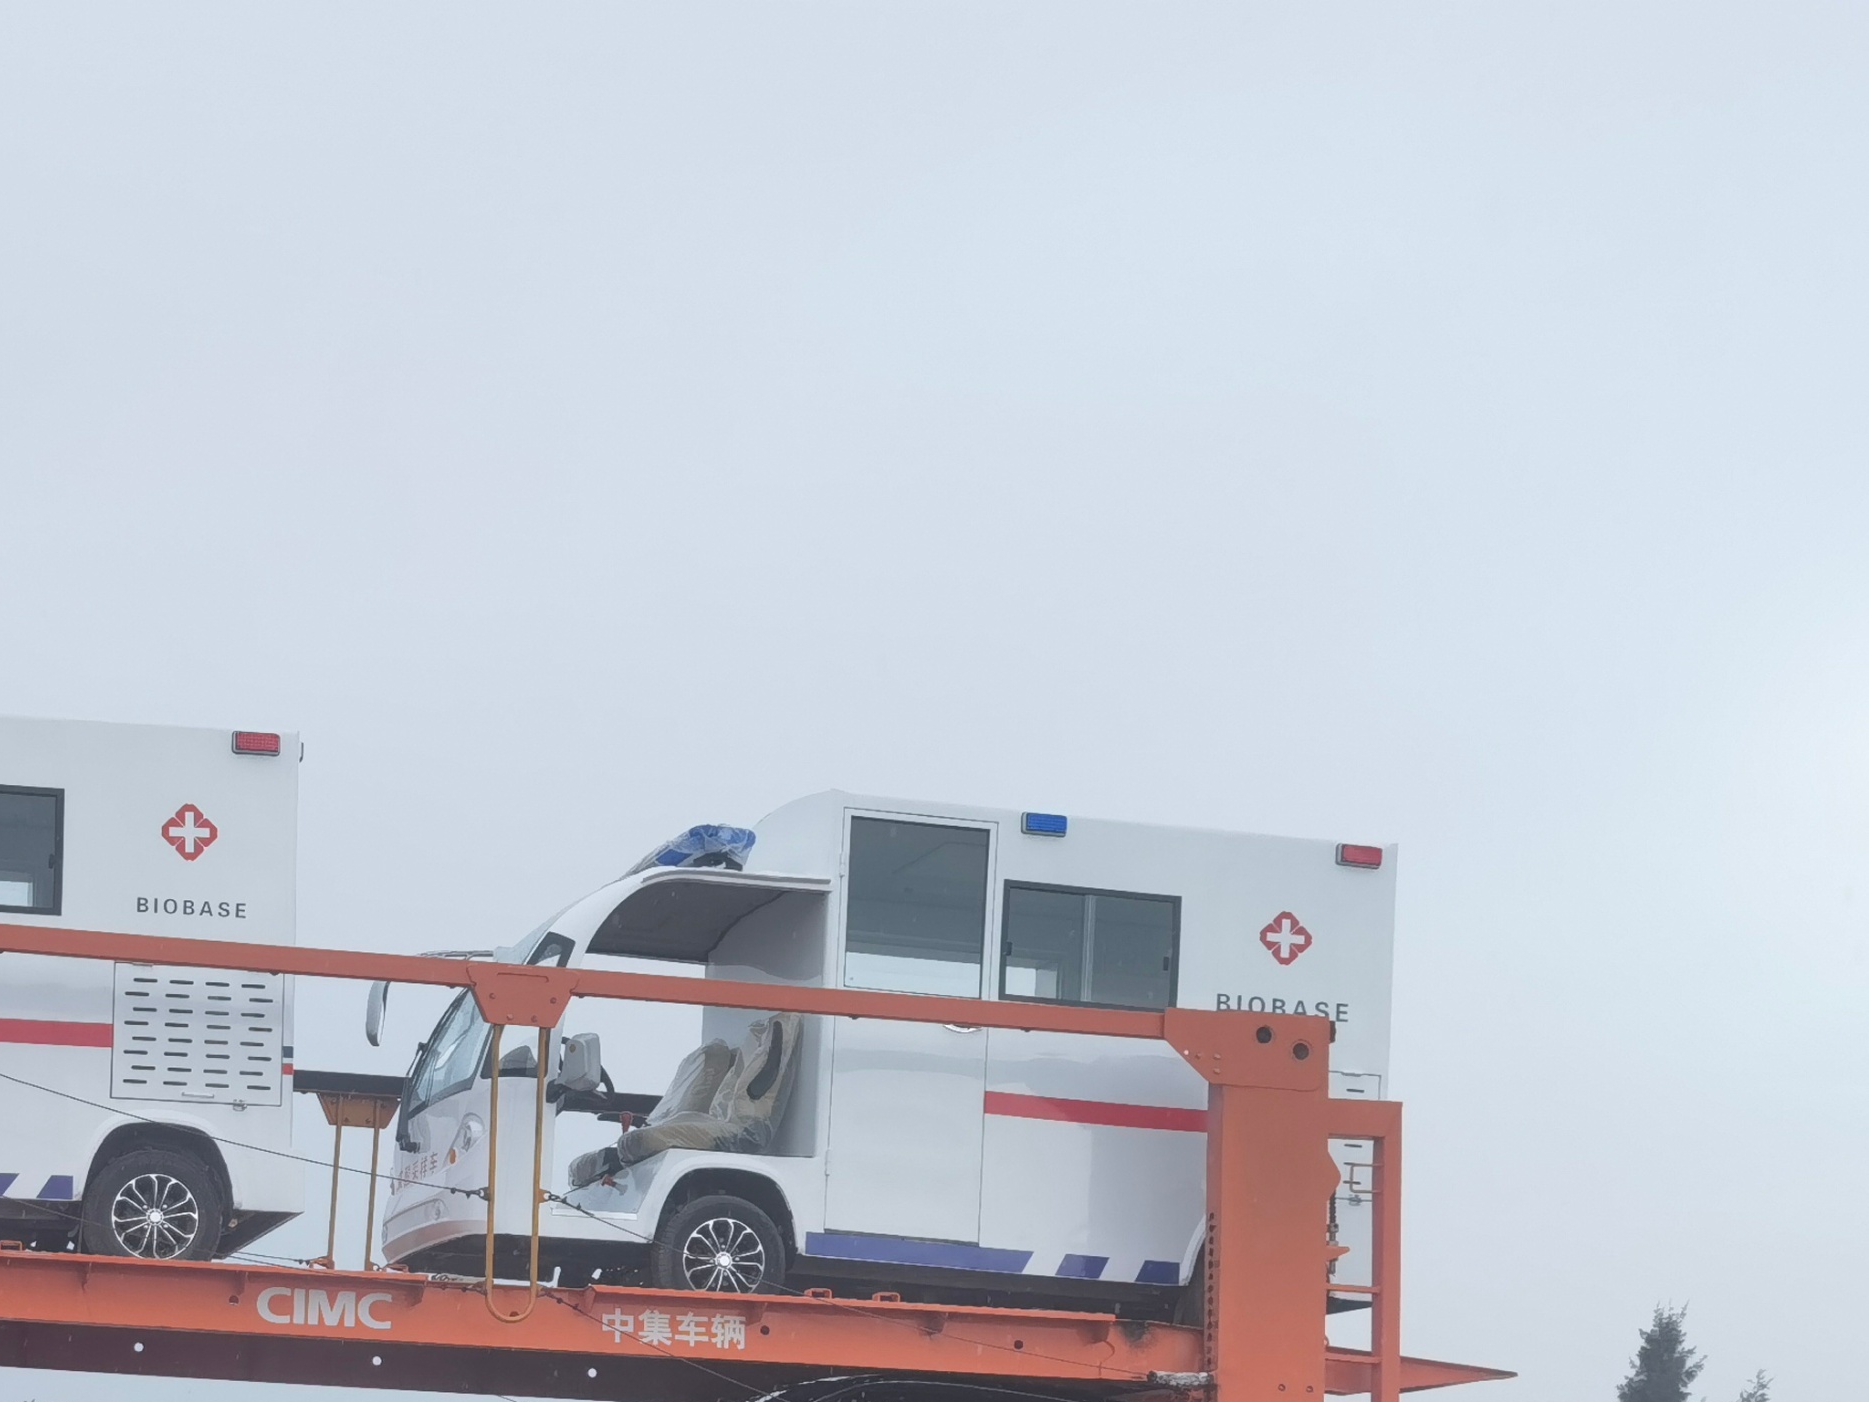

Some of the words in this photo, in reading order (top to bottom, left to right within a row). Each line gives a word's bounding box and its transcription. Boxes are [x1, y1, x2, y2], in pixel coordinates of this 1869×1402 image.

[136, 897, 247, 919] BIOBASE
[1216, 993, 1349, 1023] BIOBASE
[256, 1286, 393, 1330] CIMC
[601, 1307, 747, 1351] 中集车辆
